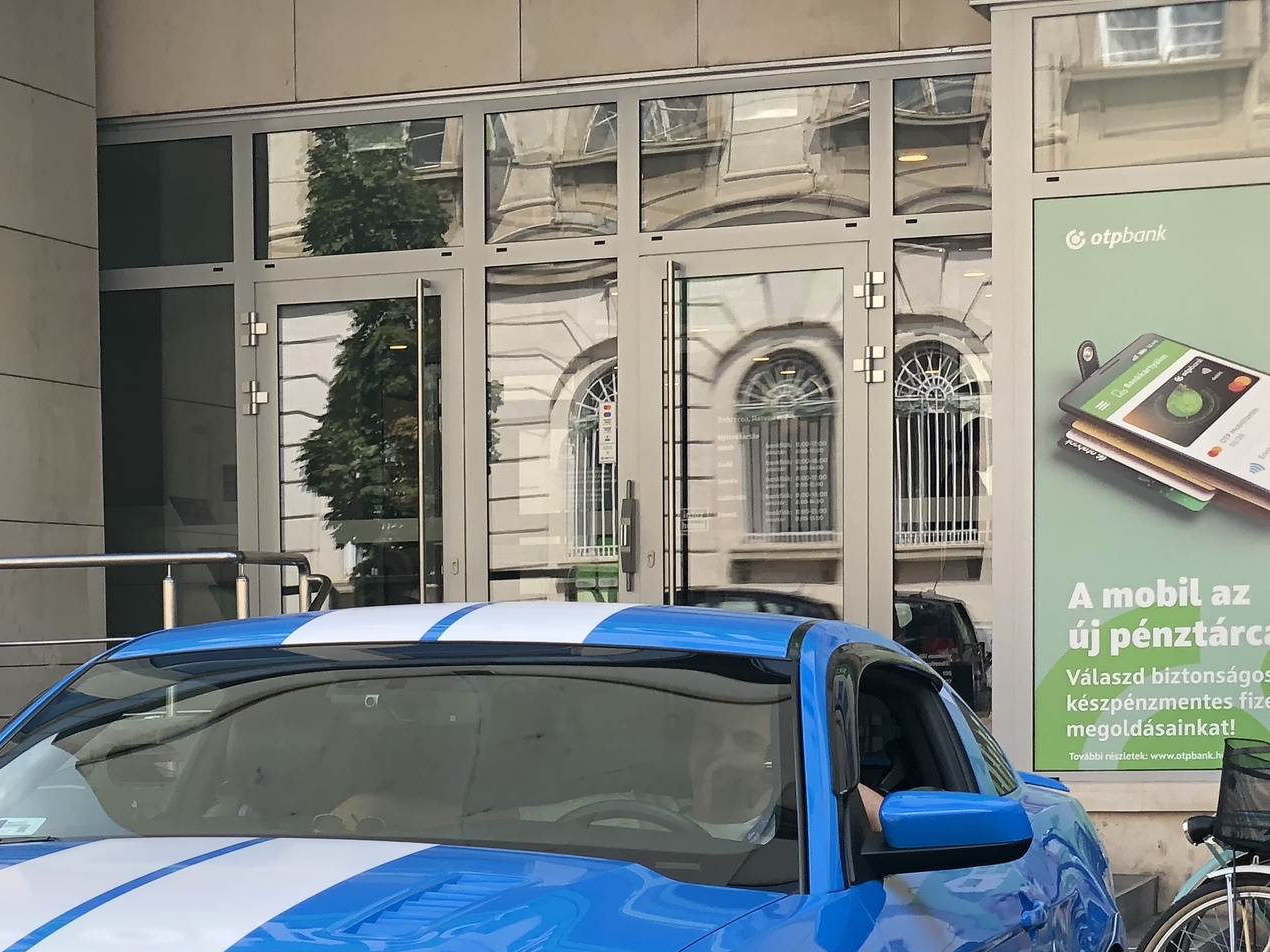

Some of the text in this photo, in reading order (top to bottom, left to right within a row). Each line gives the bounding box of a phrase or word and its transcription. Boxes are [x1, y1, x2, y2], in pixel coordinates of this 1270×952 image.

[1090, 224, 1167, 249] otpbank
[1068, 576, 1251, 609] A mobil az
[1068, 619, 1100, 657] új
[1066, 667, 1145, 686] Válaszd
[1066, 693, 1233, 715] készpénzmentes
[1066, 718, 1236, 742] megoldásainkat!
[1068, 751, 1103, 761] További
[1105, 751, 1148, 761] részletek:
